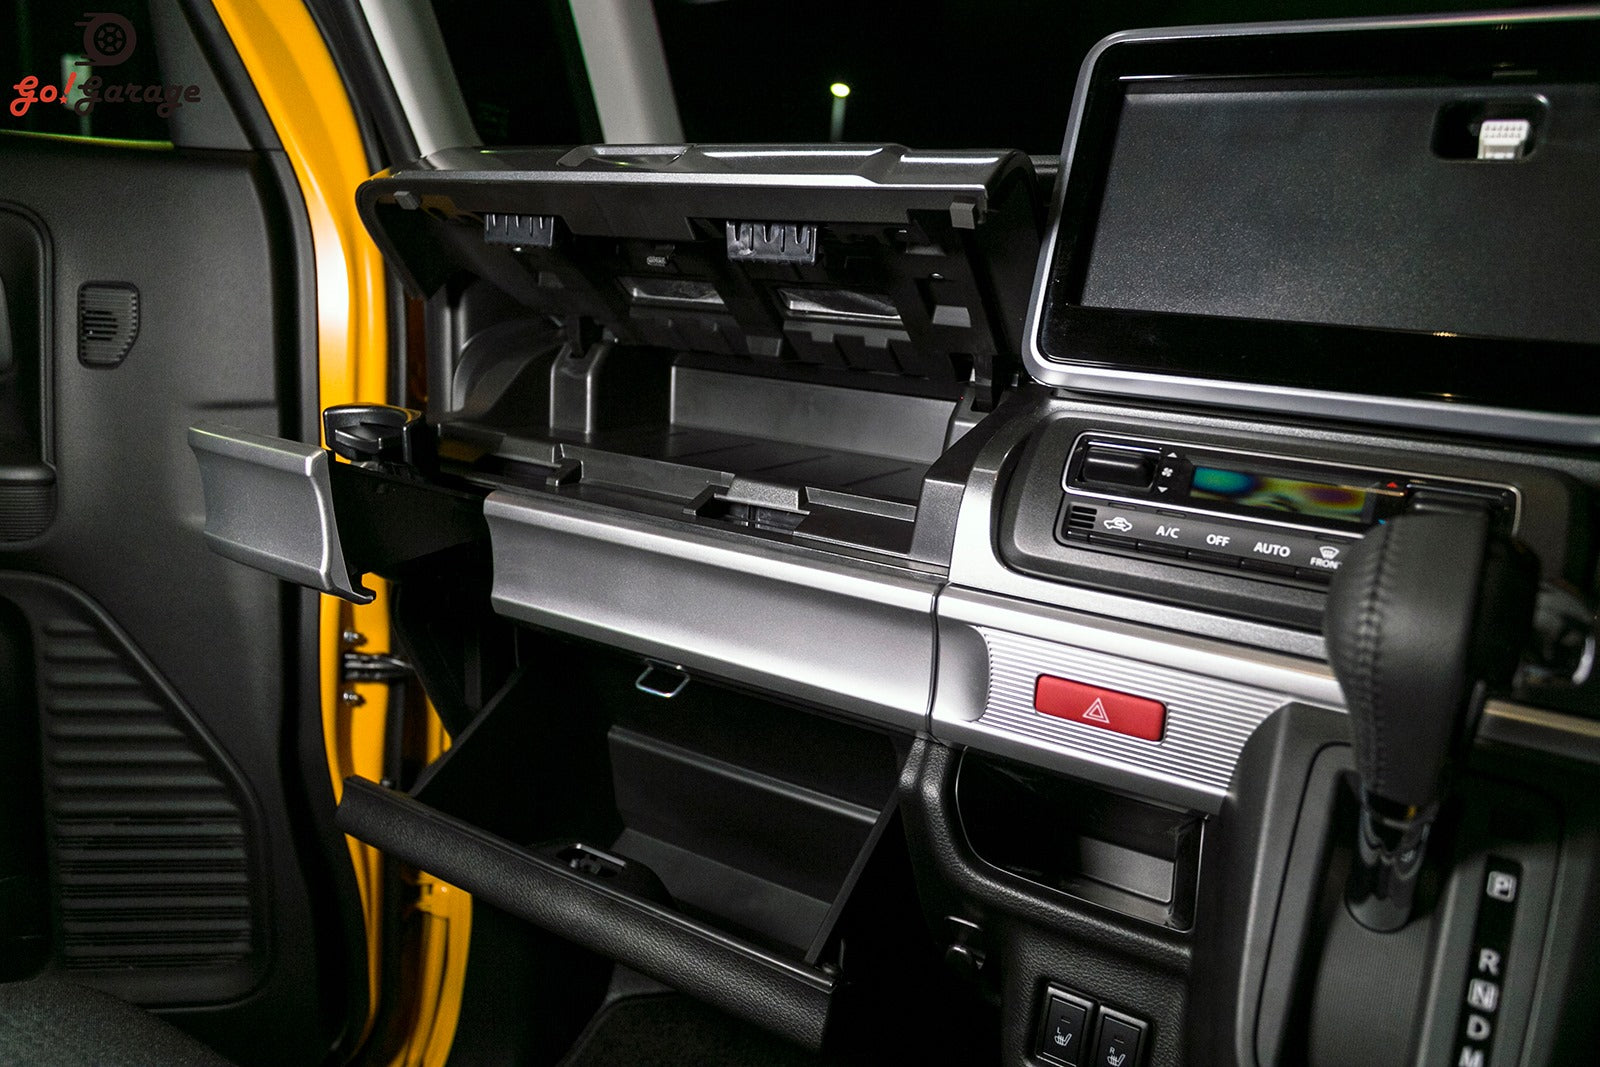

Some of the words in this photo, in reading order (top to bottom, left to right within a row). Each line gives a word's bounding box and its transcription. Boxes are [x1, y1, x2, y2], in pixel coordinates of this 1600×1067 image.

[1156, 525, 1180, 539] A/C
[1206, 533, 1231, 547] OFF
[1253, 542, 1291, 557] AUTO
[1310, 556, 1343, 570] FRON
[1493, 875, 1511, 897] P
[1478, 947, 1500, 976] R
[1472, 981, 1497, 1011] N
[1056, 1026, 1061, 1034] L
[1466, 1014, 1491, 1041] D
[1109, 1046, 1116, 1054] R
